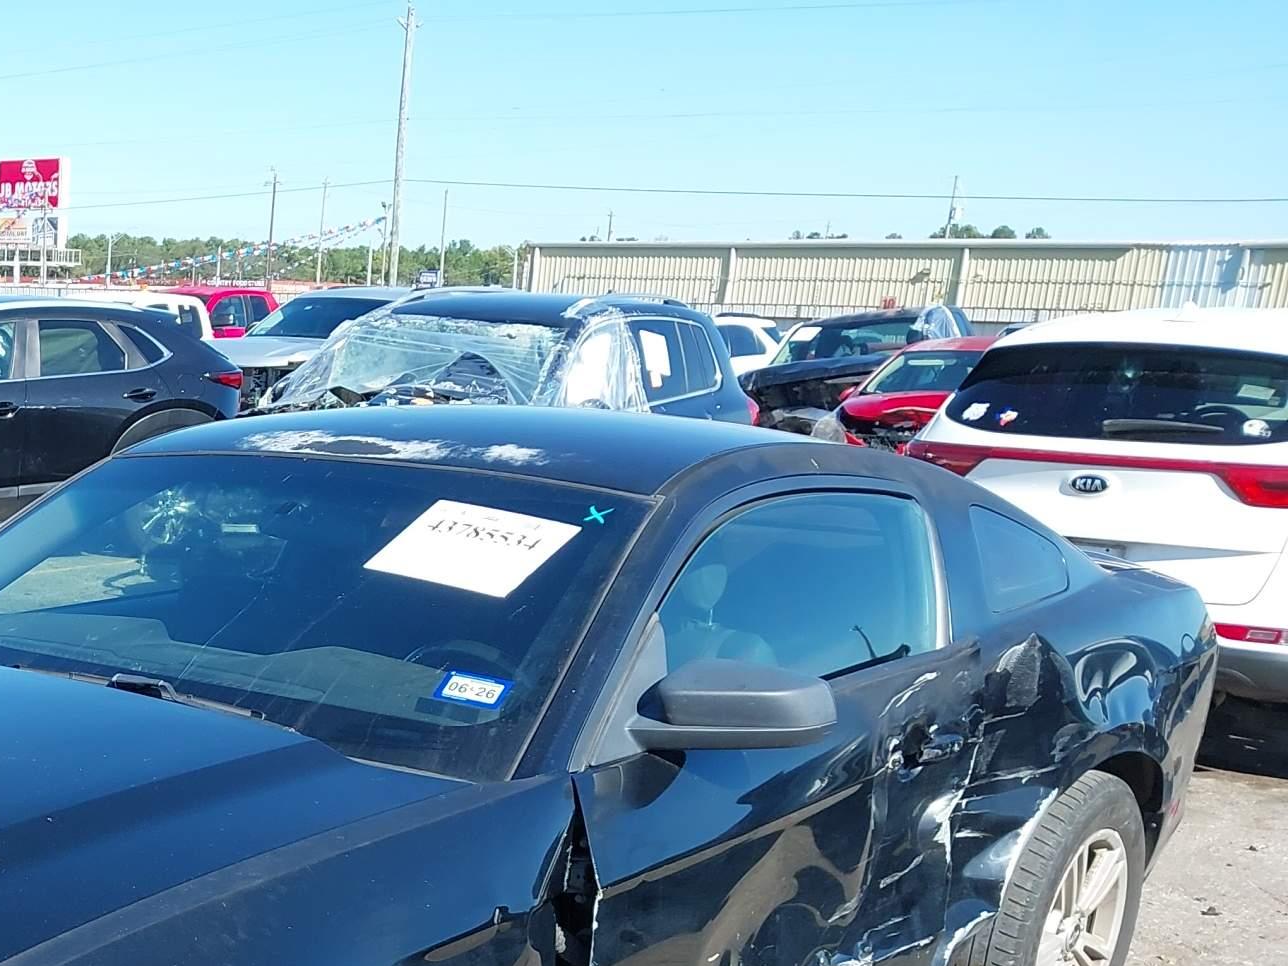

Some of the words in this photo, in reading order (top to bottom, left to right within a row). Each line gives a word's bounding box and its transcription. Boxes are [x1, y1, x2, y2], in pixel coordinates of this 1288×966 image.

[0, 182, 12, 198] JB
[1075, 478, 1103, 491] KIA
[427, 519, 542, 551] 43785534
